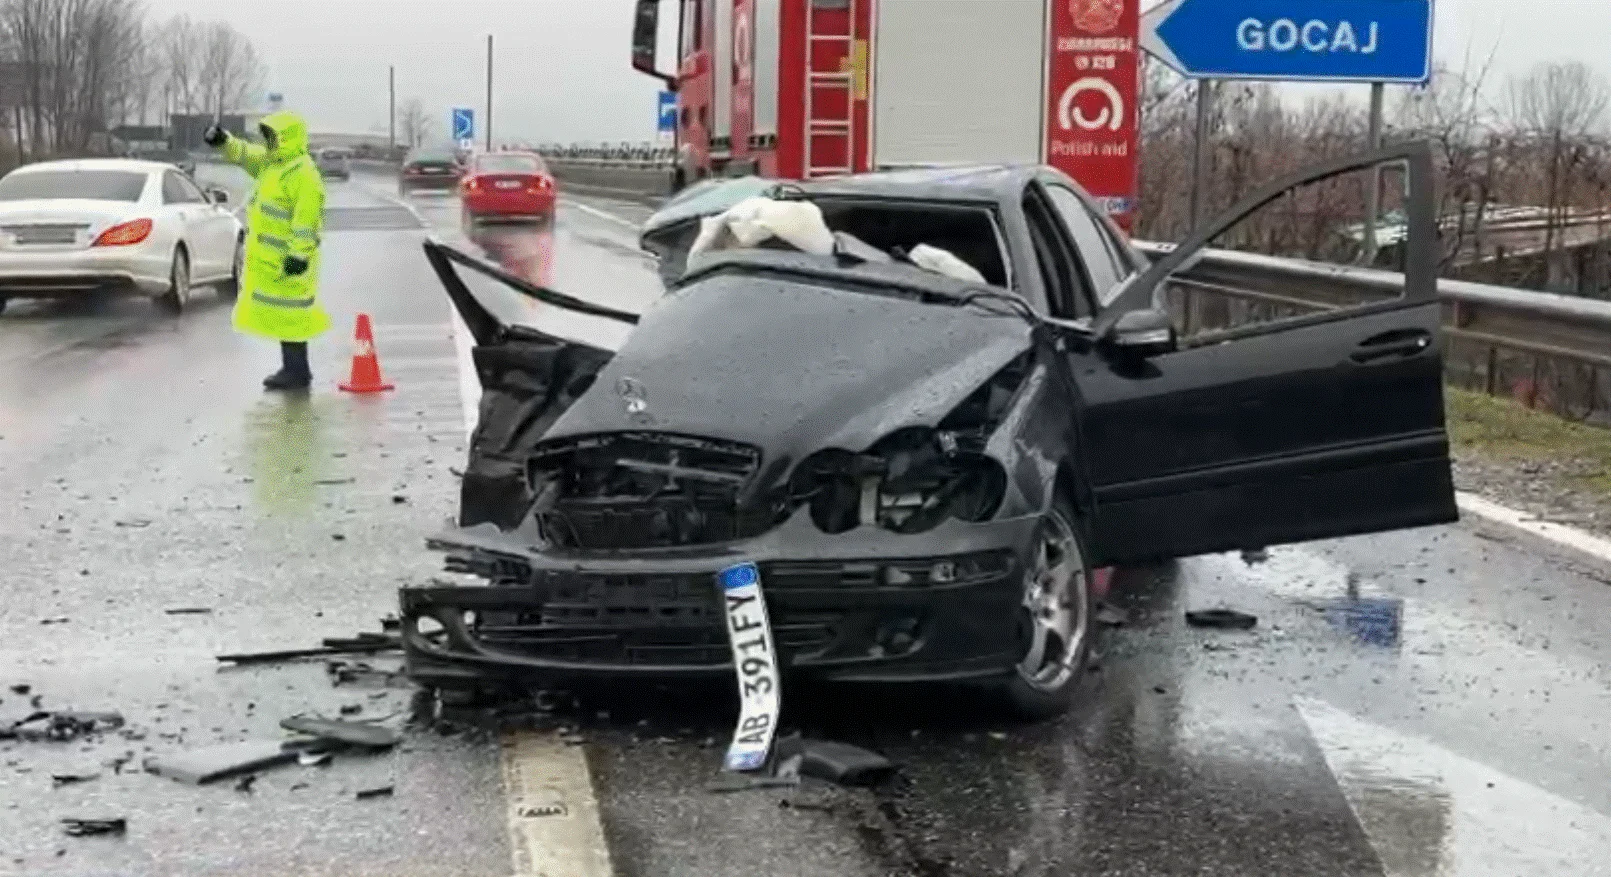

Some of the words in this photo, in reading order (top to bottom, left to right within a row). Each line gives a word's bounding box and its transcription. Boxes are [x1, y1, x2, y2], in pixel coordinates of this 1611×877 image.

[1236, 17, 1378, 54] GOCAJ
[727, 594, 772, 698] 391FY
[738, 712, 770, 744] AB
